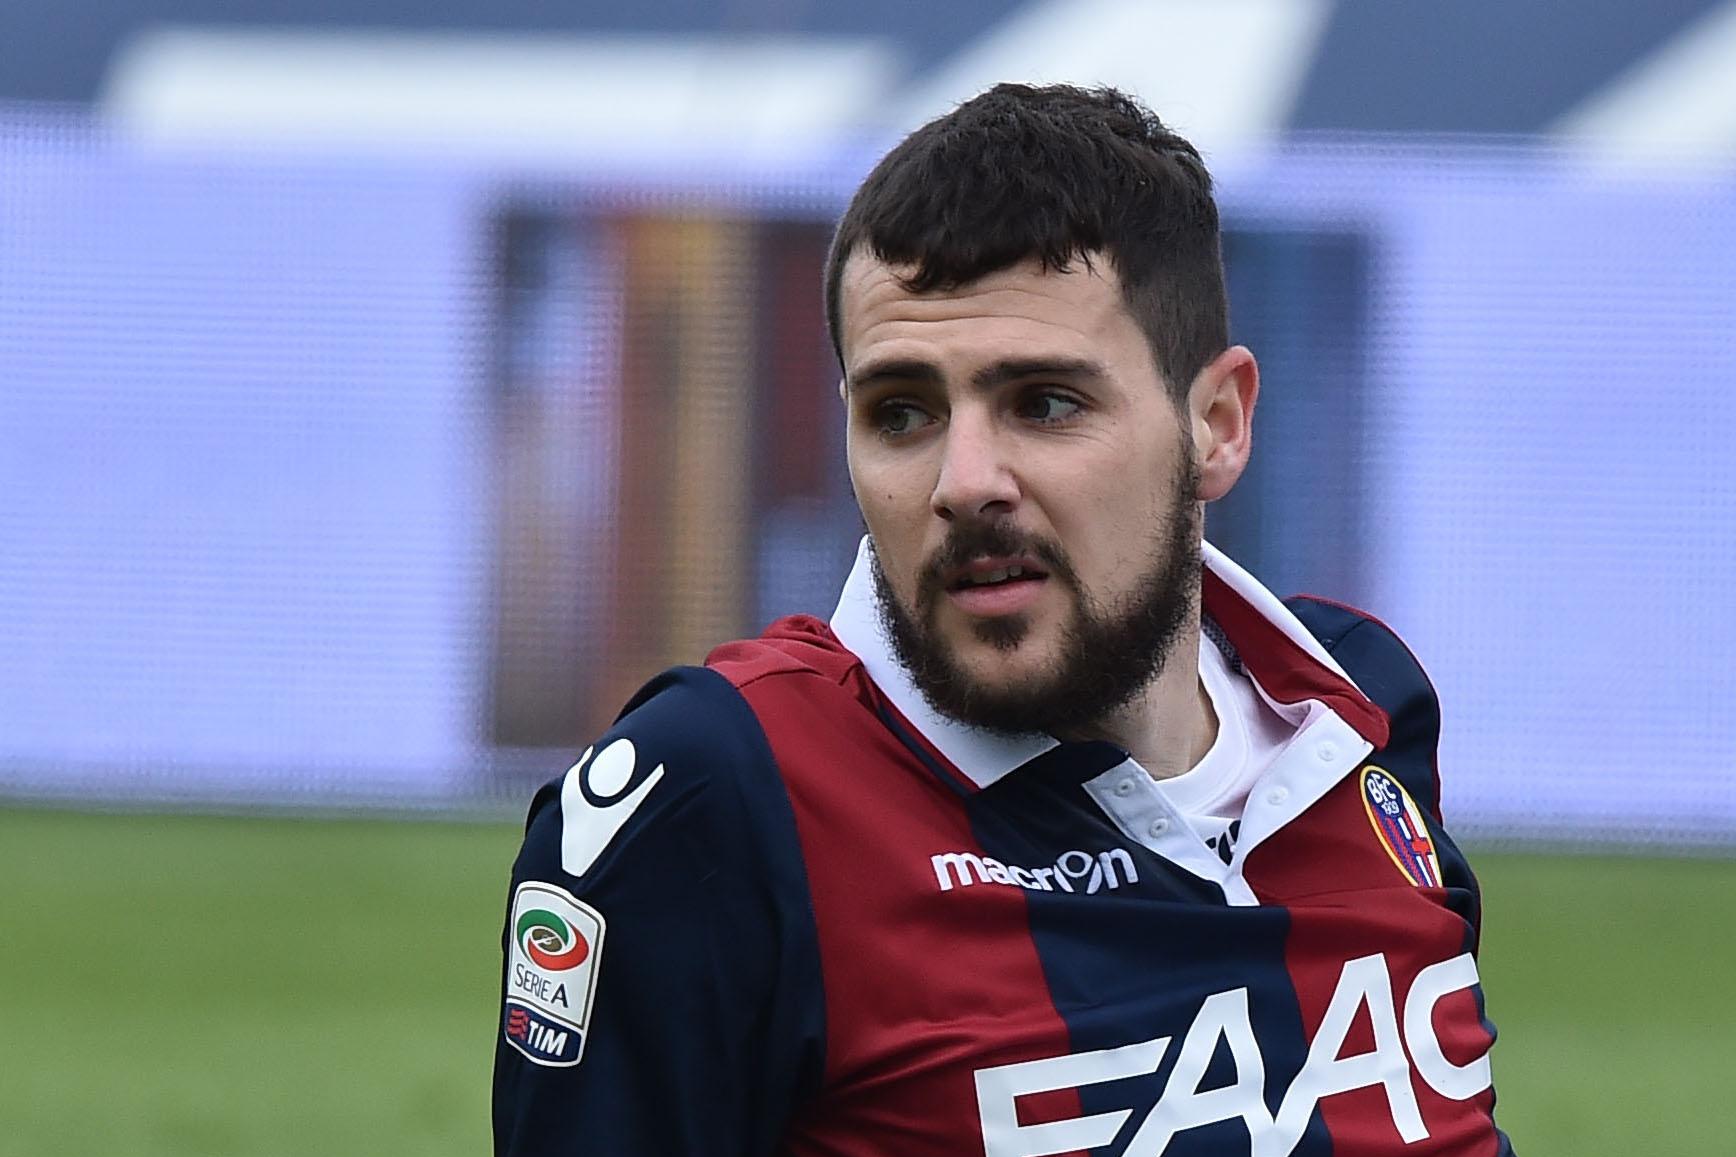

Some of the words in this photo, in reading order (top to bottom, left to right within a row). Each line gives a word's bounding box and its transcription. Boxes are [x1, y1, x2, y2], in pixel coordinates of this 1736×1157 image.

[930, 848, 1139, 894] macron
[515, 963, 552, 1002] SERIE
[550, 983, 569, 1008] A
[527, 1019, 568, 1057] TIM
